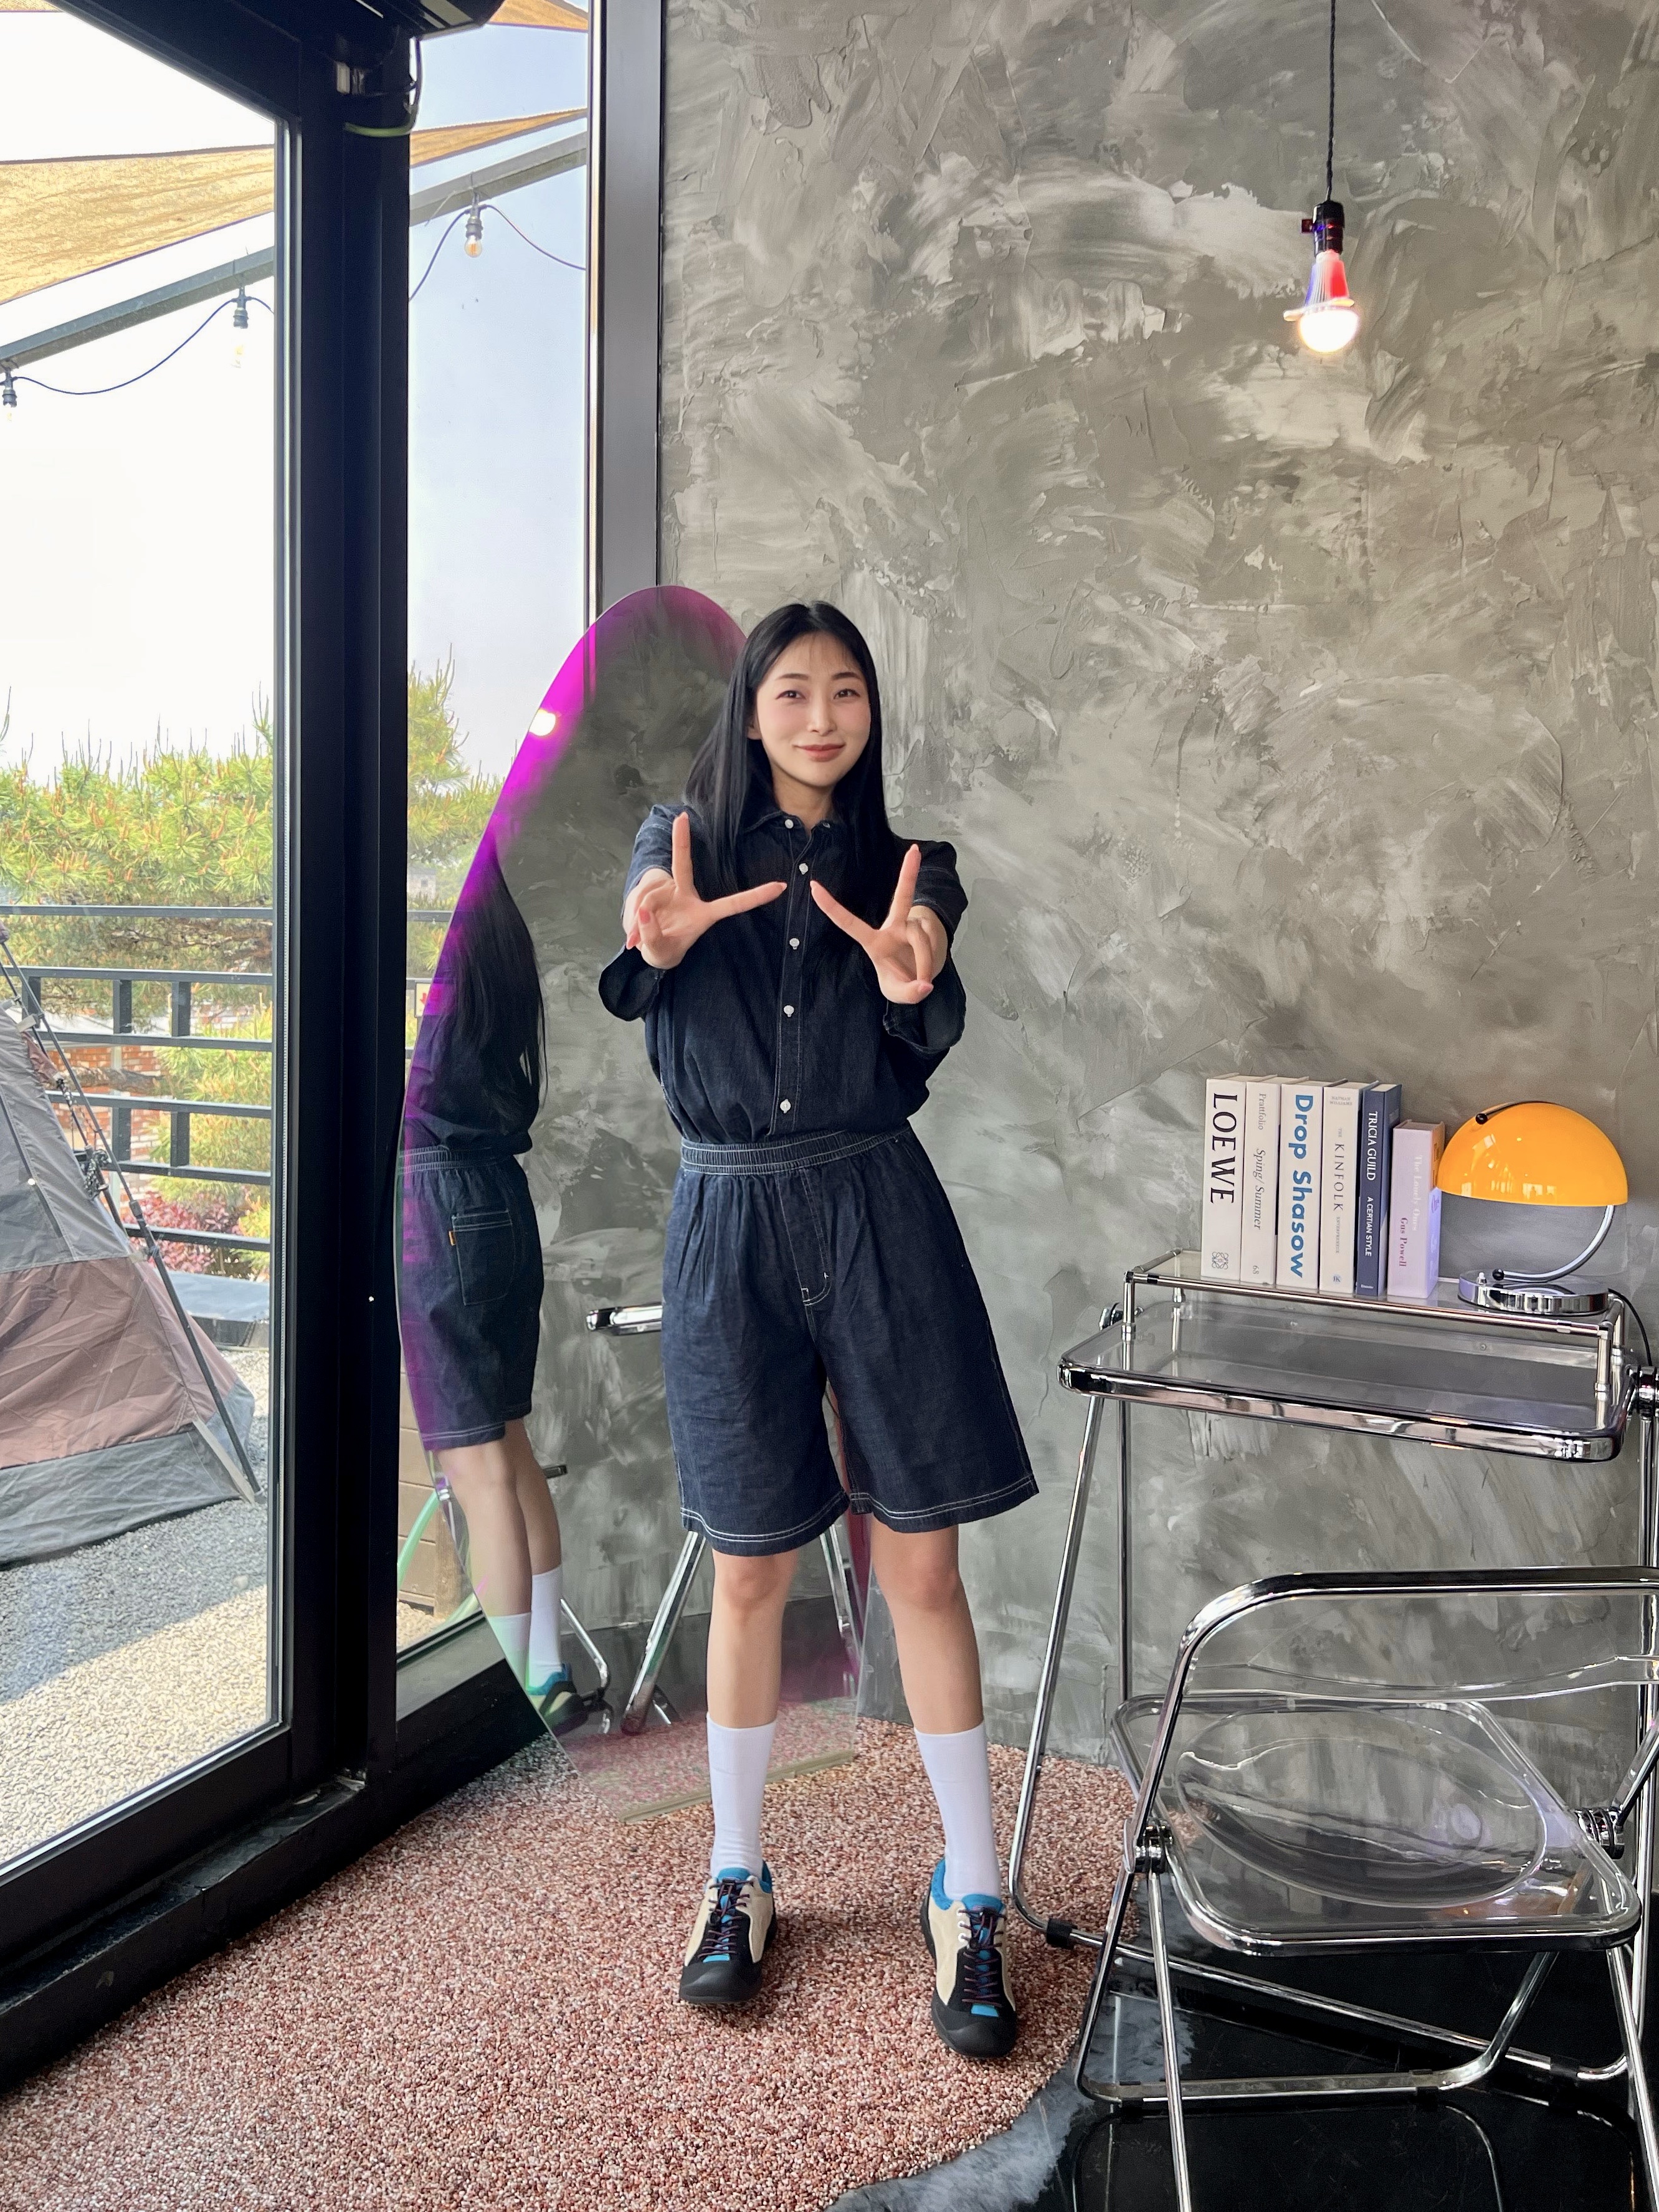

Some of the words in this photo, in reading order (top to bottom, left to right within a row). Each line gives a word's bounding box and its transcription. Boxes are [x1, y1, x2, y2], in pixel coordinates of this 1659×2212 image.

[1258, 1093, 1267, 1130] Prattfolio
[1288, 1094, 1313, 1159] Drop
[1367, 1111, 1378, 1146] TRICIA
[1210, 1093, 1238, 1203] LOEWE
[1366, 1148, 1377, 1181] GUILD
[1414, 1155, 1422, 1172] The
[1333, 1143, 1344, 1211] KINFOLK
[1254, 1185, 1265, 1230] Summer
[1290, 1170, 1313, 1278] Shasow
[1366, 1203, 1374, 1234] CERTIAN
[1400, 1217, 1409, 1235] Gus
[1399, 1237, 1407, 1266] Powell
